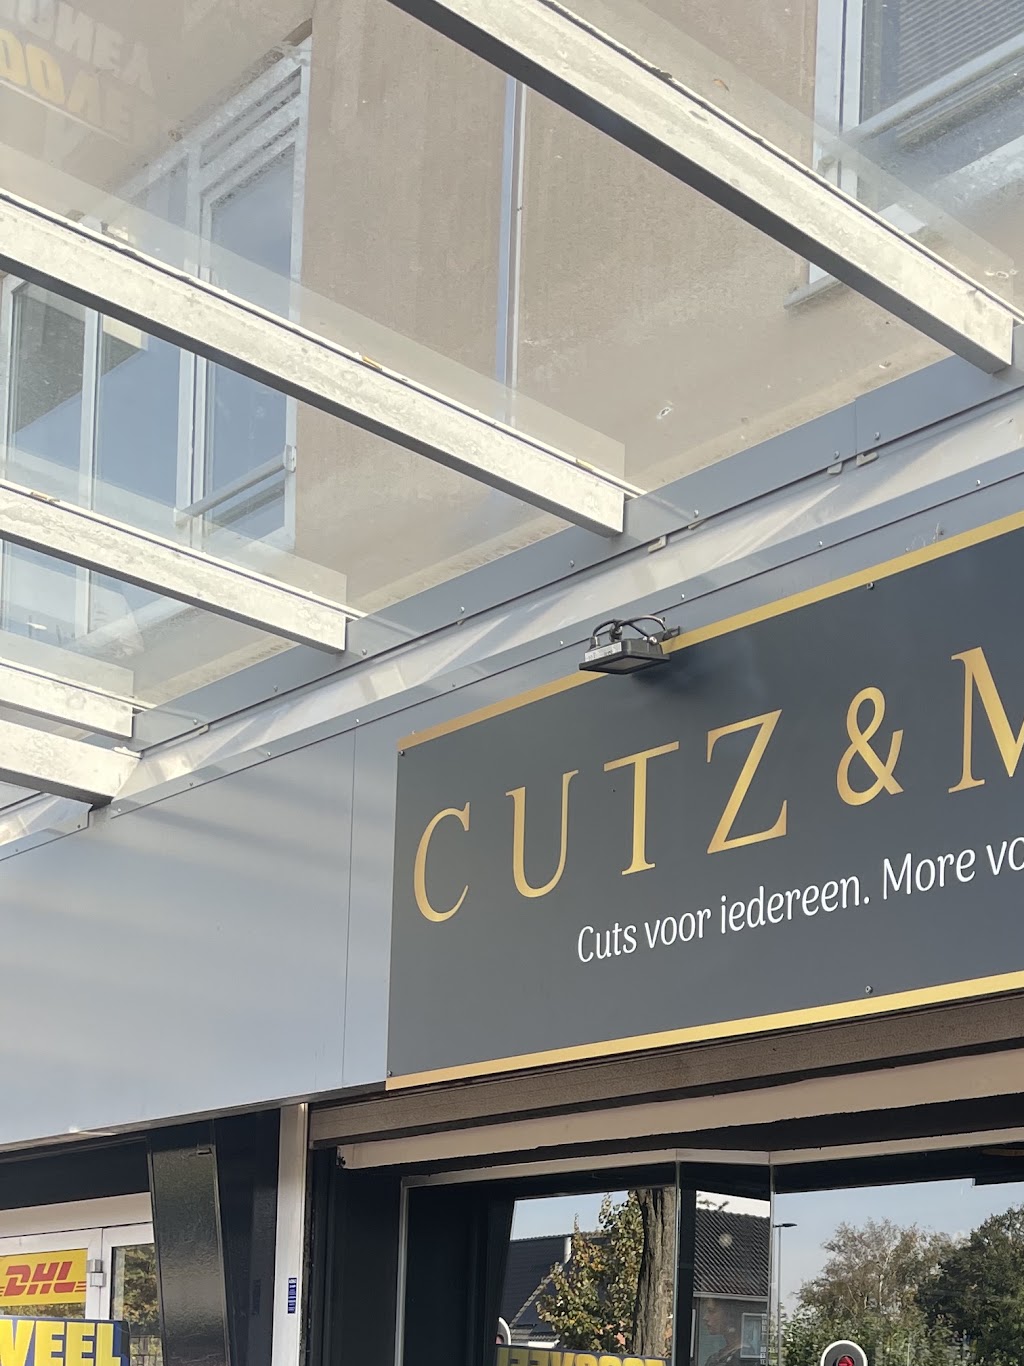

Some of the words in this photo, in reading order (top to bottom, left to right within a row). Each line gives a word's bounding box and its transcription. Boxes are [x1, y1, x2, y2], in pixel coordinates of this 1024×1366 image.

[413, 709, 787, 922] CUTZ
[836, 686, 903, 806] &
[577, 922, 637, 963] Cuts
[644, 908, 712, 949] voor
[720, 874, 870, 935] iedereen.
[882, 849, 976, 900] More
[4, 1261, 76, 1297] DHL
